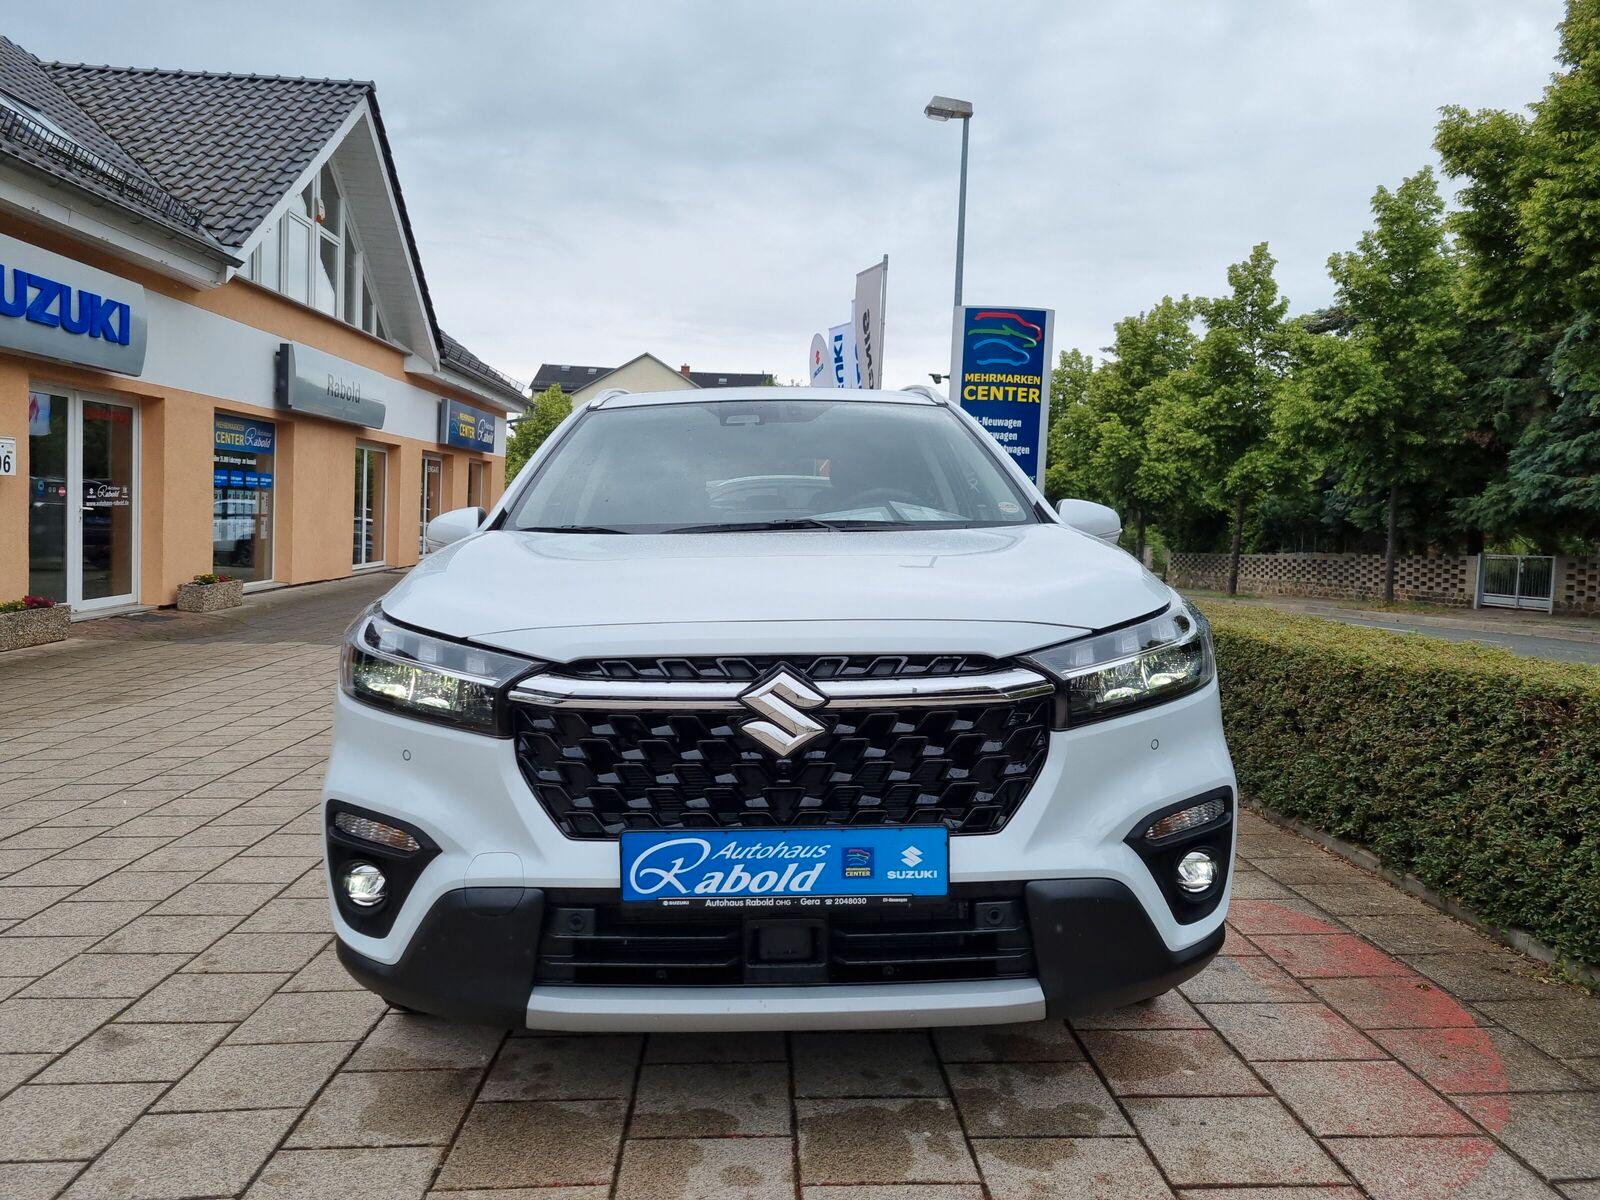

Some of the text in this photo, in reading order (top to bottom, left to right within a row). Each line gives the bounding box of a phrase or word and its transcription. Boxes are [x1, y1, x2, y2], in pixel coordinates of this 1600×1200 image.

[965, 373, 1041, 385] MEHRMARKEN
[327, 373, 361, 404] Rabold
[963, 385, 1041, 404] CENTER
[215, 431, 245, 446] CENTER
[244, 427, 272, 448] Rabold
[460, 424, 476, 439] CENTER
[0, 455, 11, 473] 6
[97, 484, 120, 498] Rabold
[712, 841, 831, 860] Autohaus
[629, 837, 826, 894] Rabold
[887, 870, 938, 879] SUZUKI
[705, 899, 744, 907] Autohaus
[745, 898, 774, 906] Rabold
[800, 898, 821, 906] Gera
[834, 897, 867, 905] 2048030
